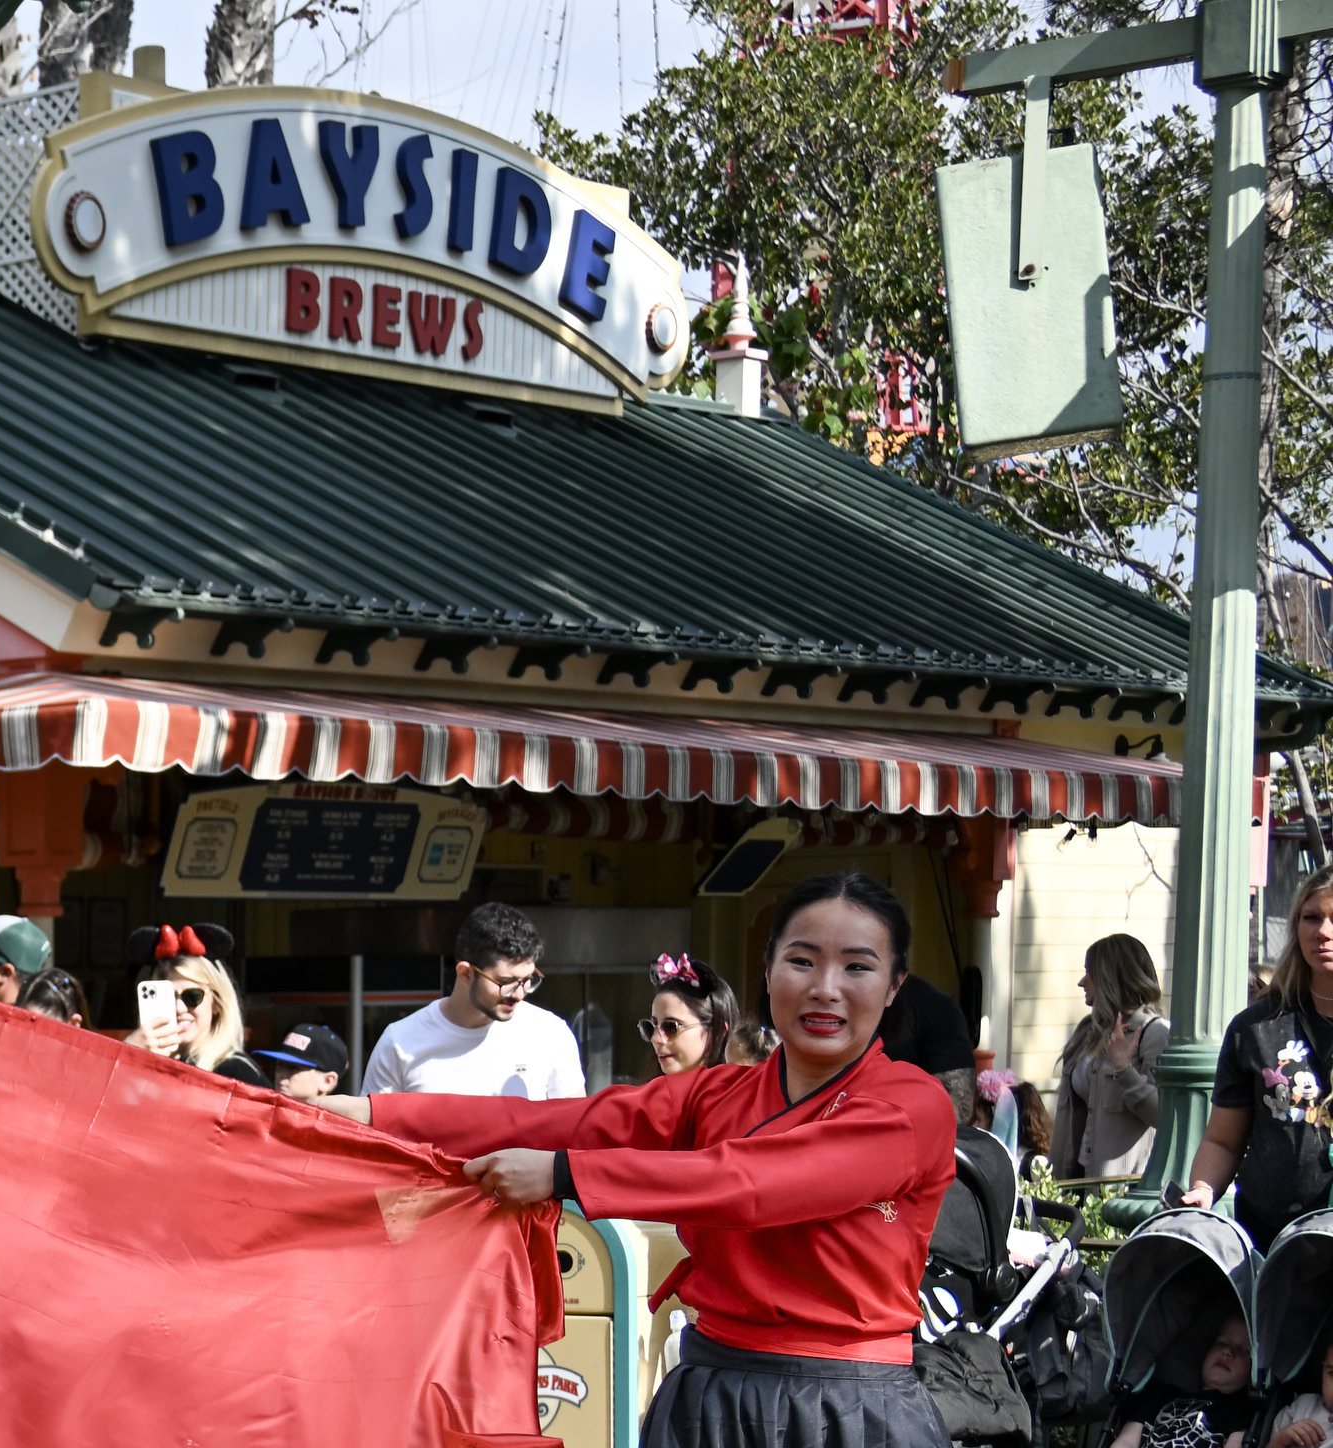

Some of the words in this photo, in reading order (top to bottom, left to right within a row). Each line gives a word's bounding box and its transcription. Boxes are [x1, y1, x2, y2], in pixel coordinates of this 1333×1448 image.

[149, 117, 616, 322] BAYSIDE
[285, 267, 485, 360] BREWS
[552, 1375, 579, 1396] PARK
